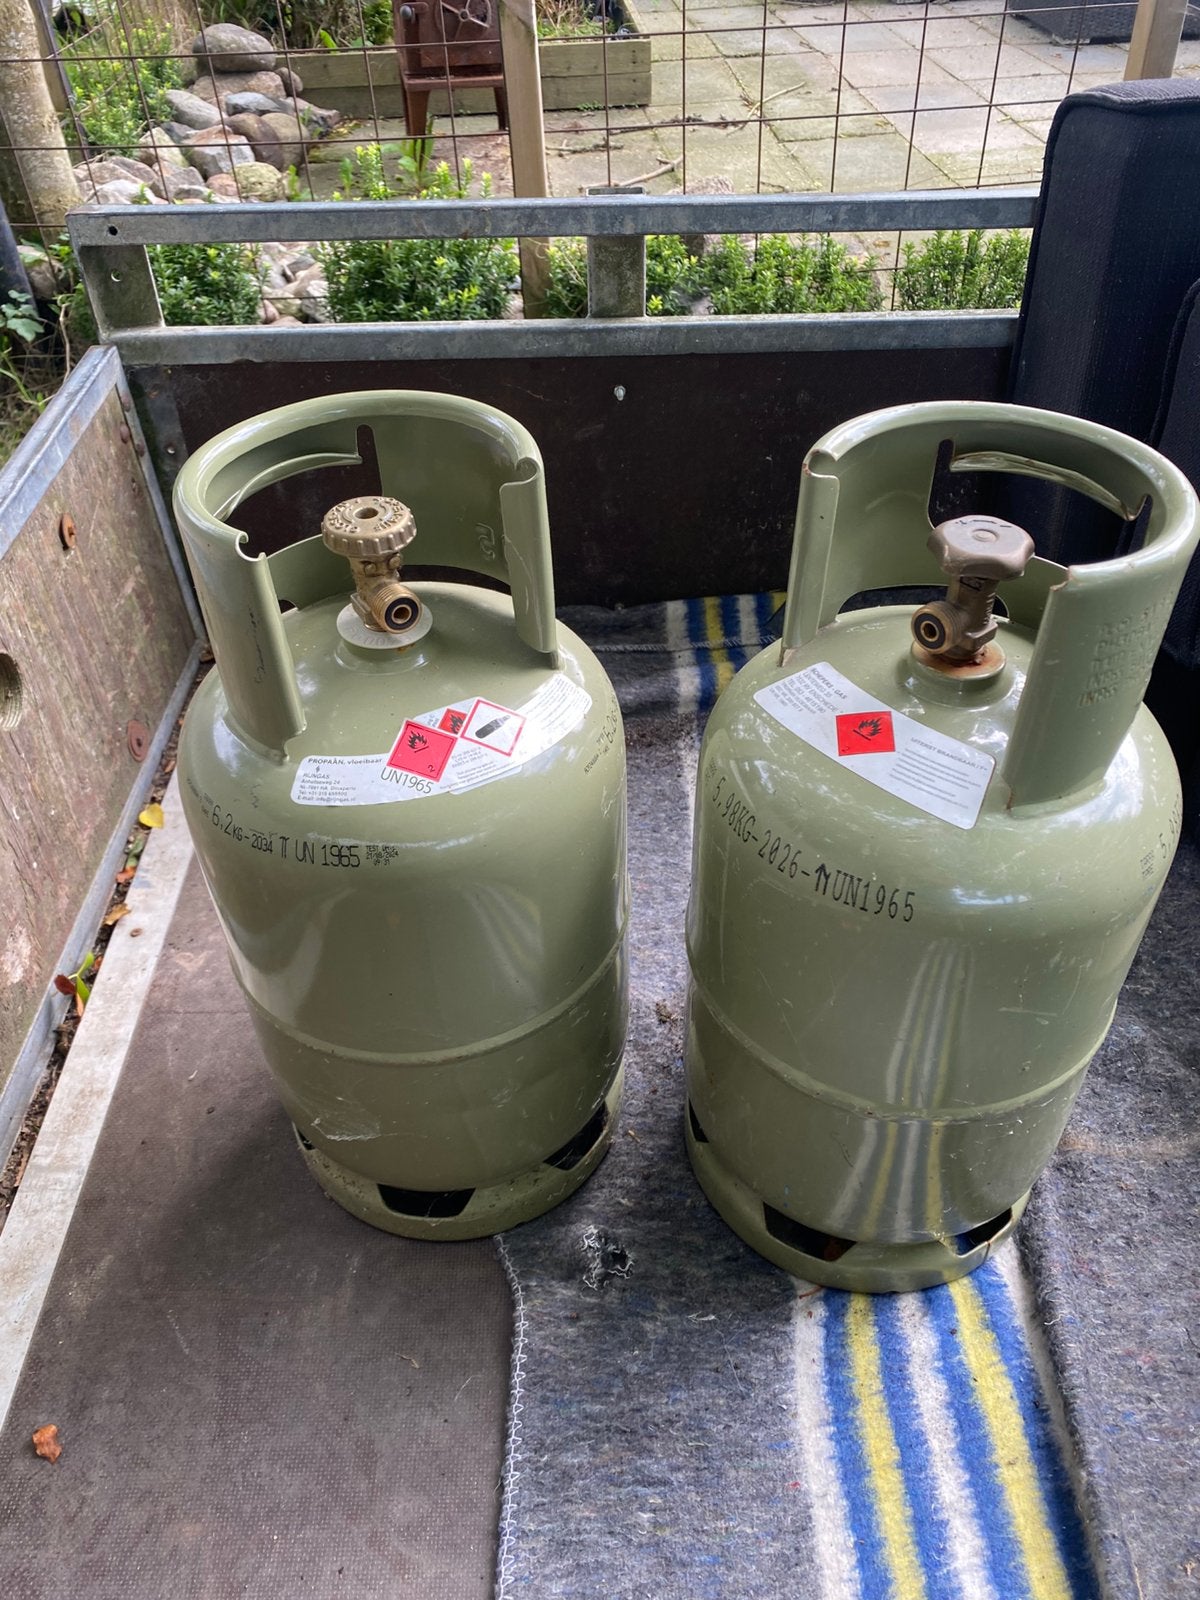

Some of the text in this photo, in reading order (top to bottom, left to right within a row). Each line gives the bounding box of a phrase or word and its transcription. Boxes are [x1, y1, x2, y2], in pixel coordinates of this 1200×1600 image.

[380, 767, 434, 794] UN1965
[428, 764, 436, 772] 2
[295, 840, 315, 865] UN
[321, 845, 361, 868] 1965
